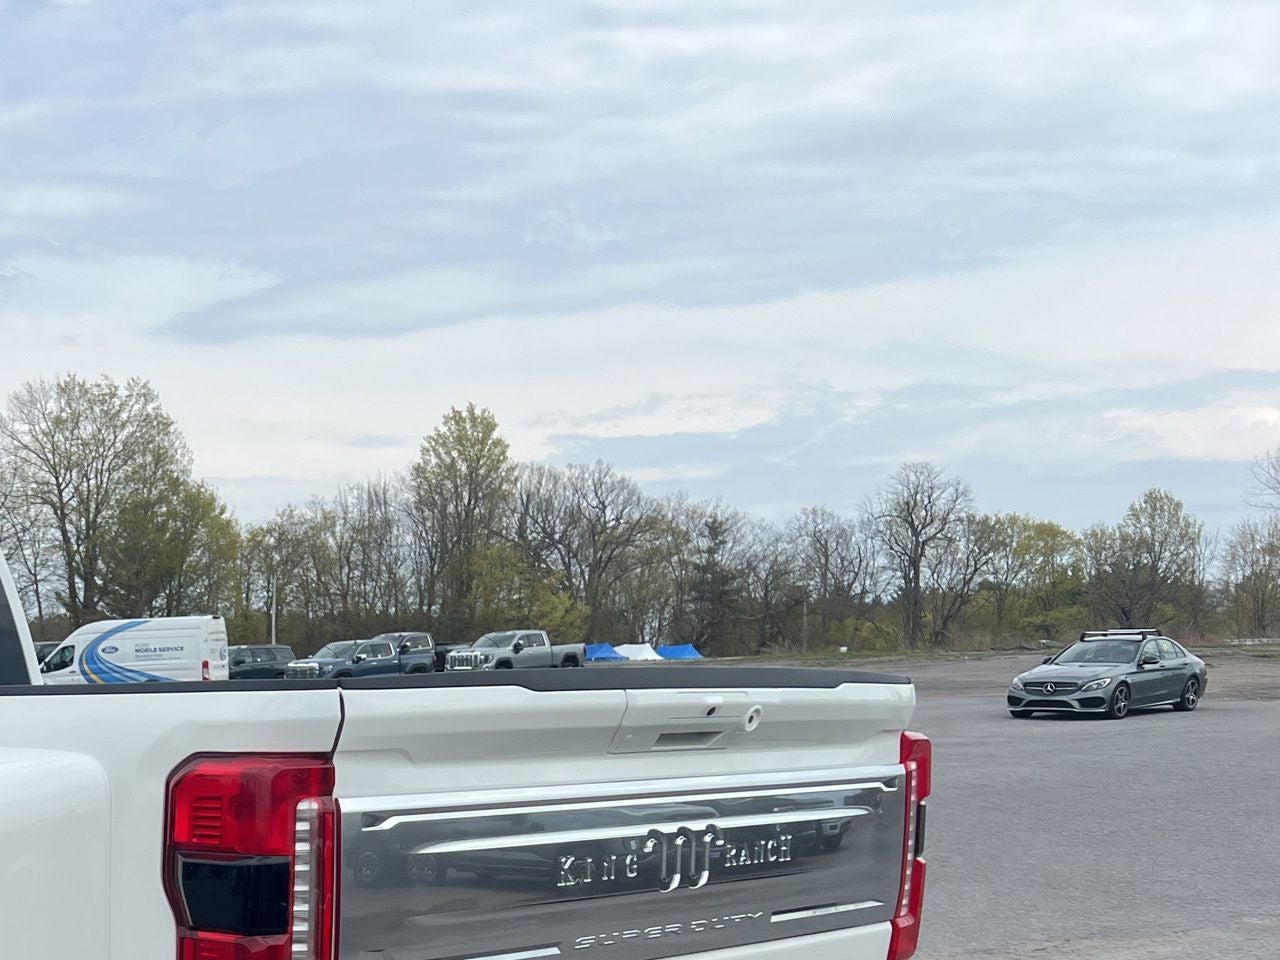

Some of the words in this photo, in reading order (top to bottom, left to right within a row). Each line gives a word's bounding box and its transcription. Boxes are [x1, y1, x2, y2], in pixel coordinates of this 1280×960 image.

[557, 853, 638, 887] KING
[725, 835, 793, 867] RANCH
[574, 923, 683, 950] SUPER
[690, 911, 764, 932] DUTY
